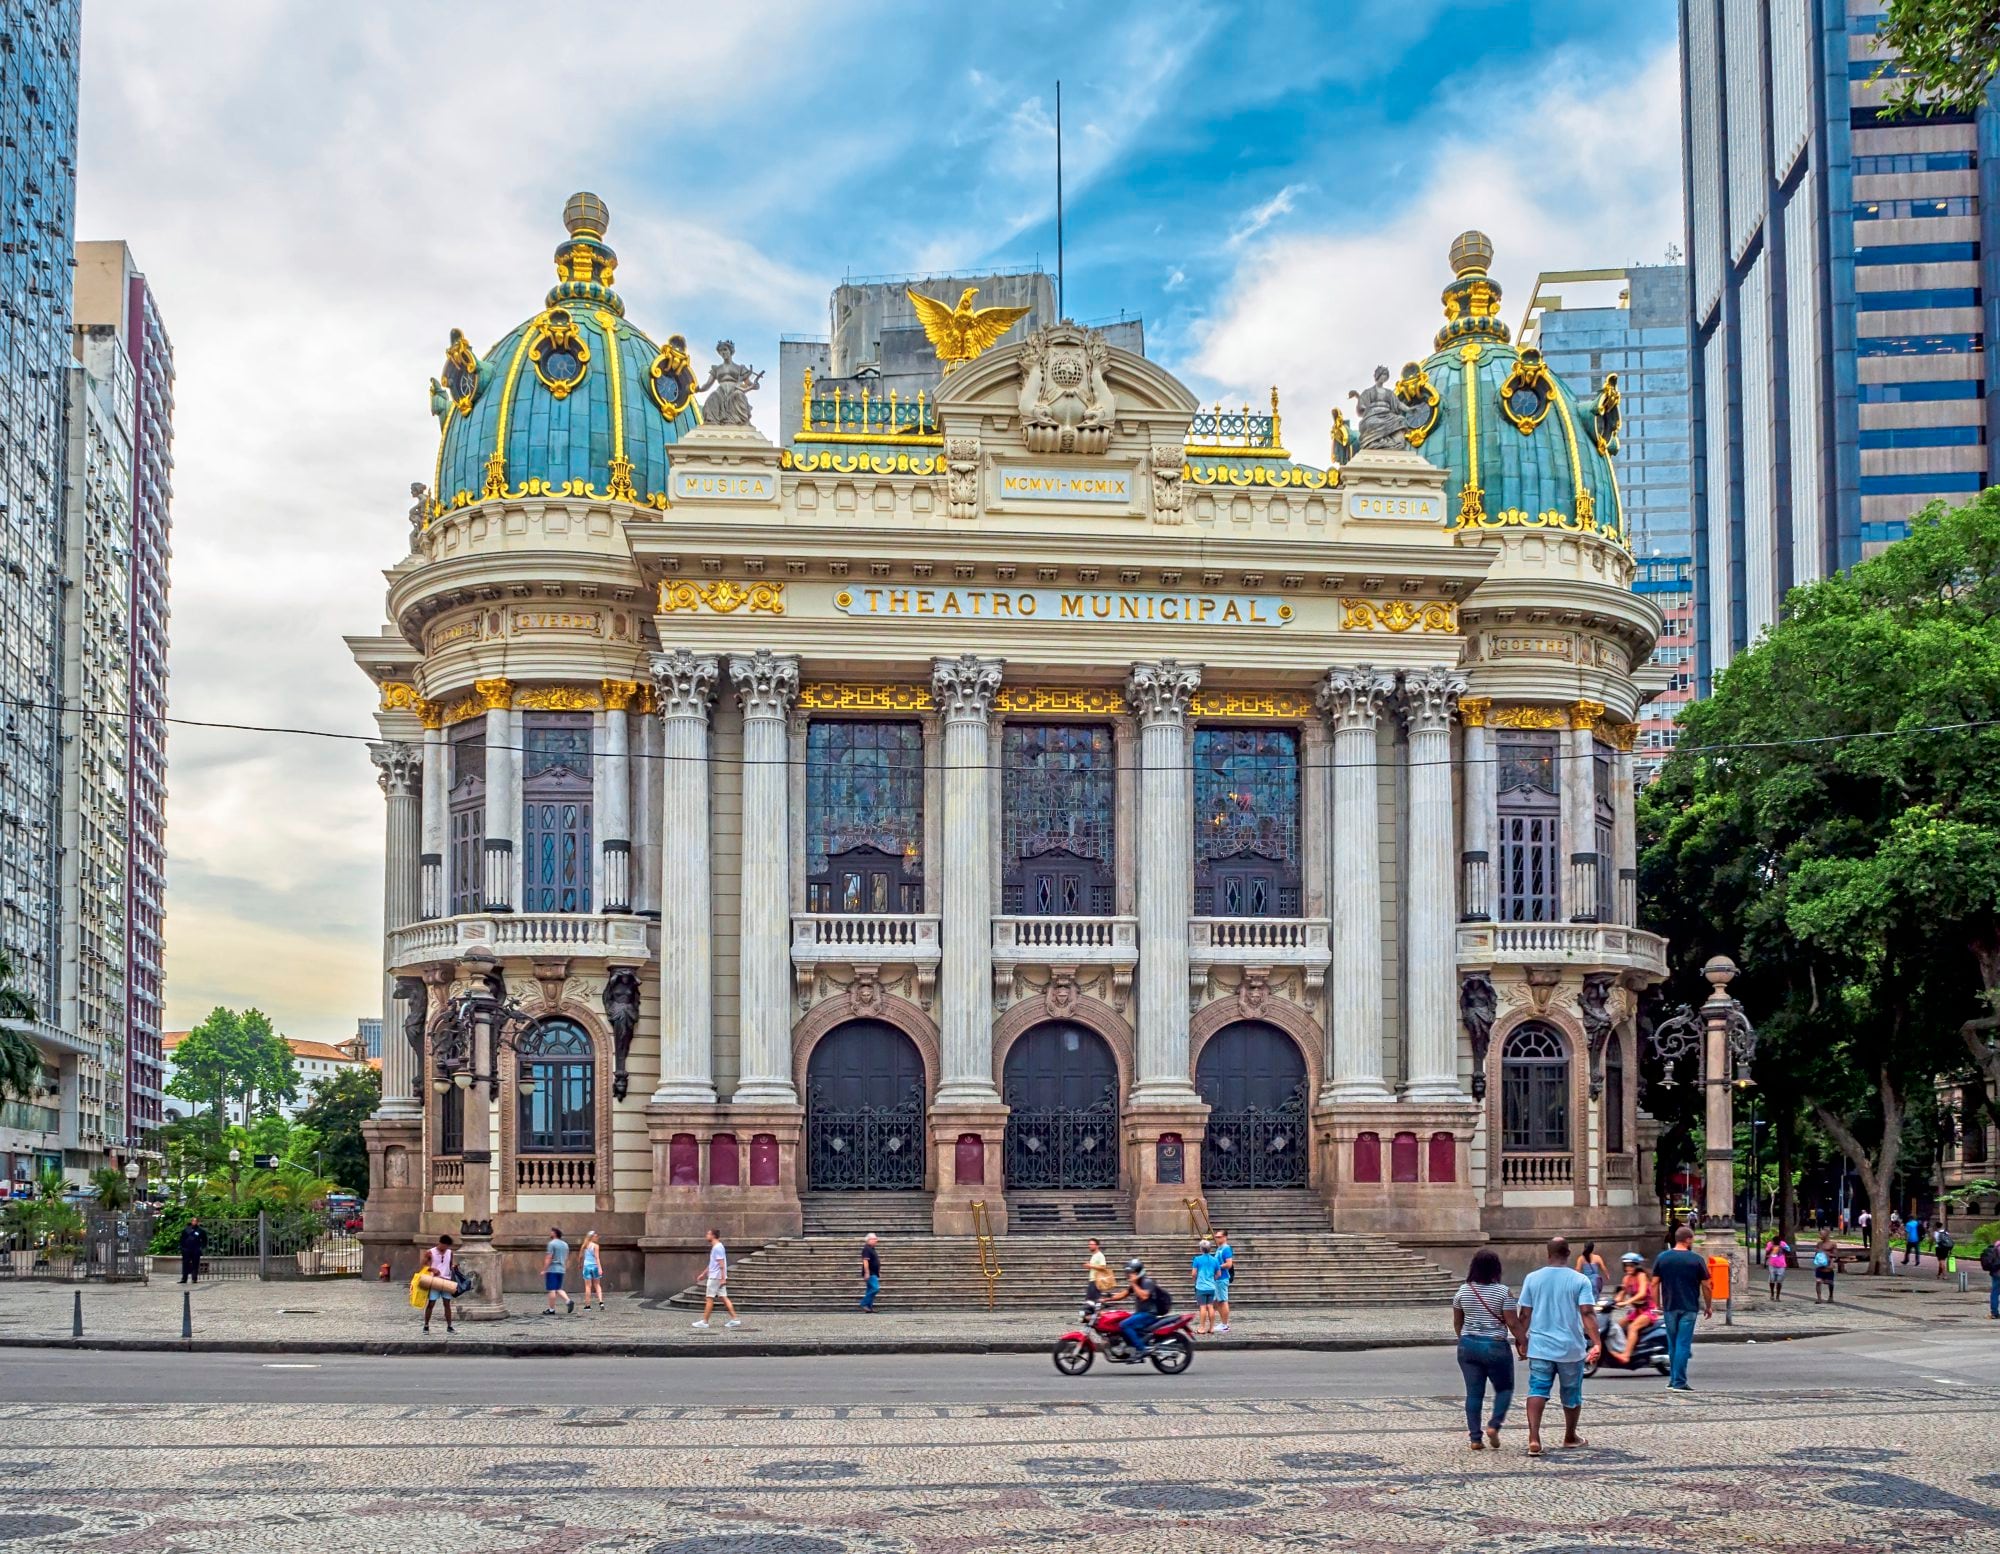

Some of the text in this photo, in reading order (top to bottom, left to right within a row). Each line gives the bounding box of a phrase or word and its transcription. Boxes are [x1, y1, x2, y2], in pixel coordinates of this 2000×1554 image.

[686, 478, 764, 494] MUSICA
[1005, 477, 1125, 494] MCMVI-MCMIX
[1360, 499, 1430, 514] POESIA
[864, 589, 1267, 622] THEATRO MUNICIPAL
[1500, 640, 1564, 652] GOETHE
